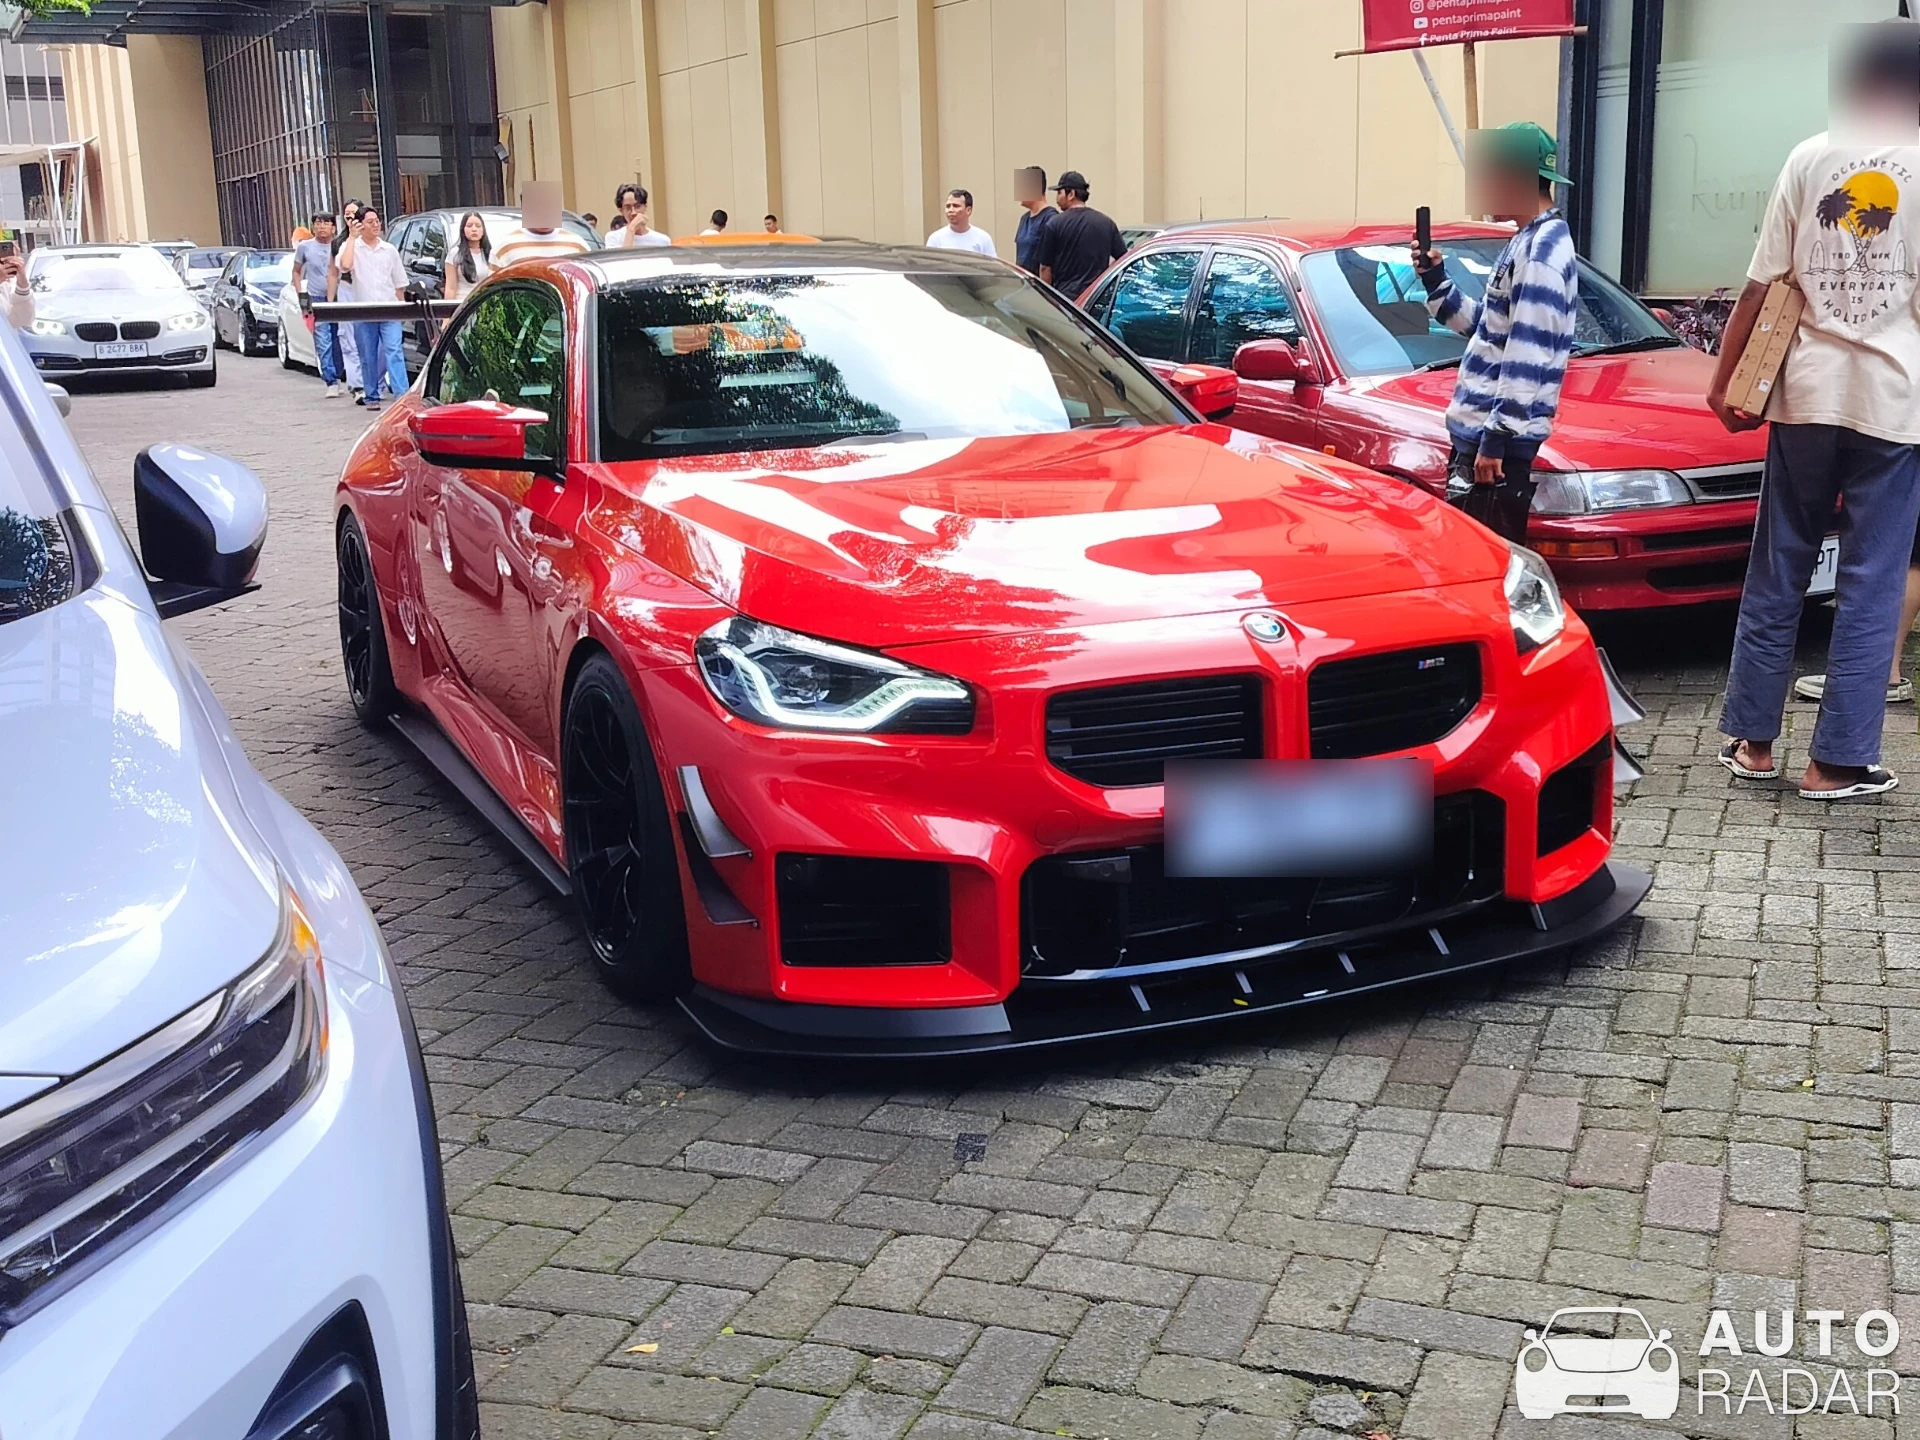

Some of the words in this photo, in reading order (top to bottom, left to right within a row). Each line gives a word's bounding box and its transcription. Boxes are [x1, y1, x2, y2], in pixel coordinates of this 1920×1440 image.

[1432, 8, 1522, 28] pentaprimapaint
[1429, 33, 1459, 43] Penta
[1460, 29, 1489, 39] Prima
[1490, 26, 1517, 36] Paint
[1819, 281, 1896, 292] EVERYDAY
[1851, 296, 1863, 304] IS
[1823, 299, 1888, 324] HOLIDAY
[99, 345, 104, 354] B
